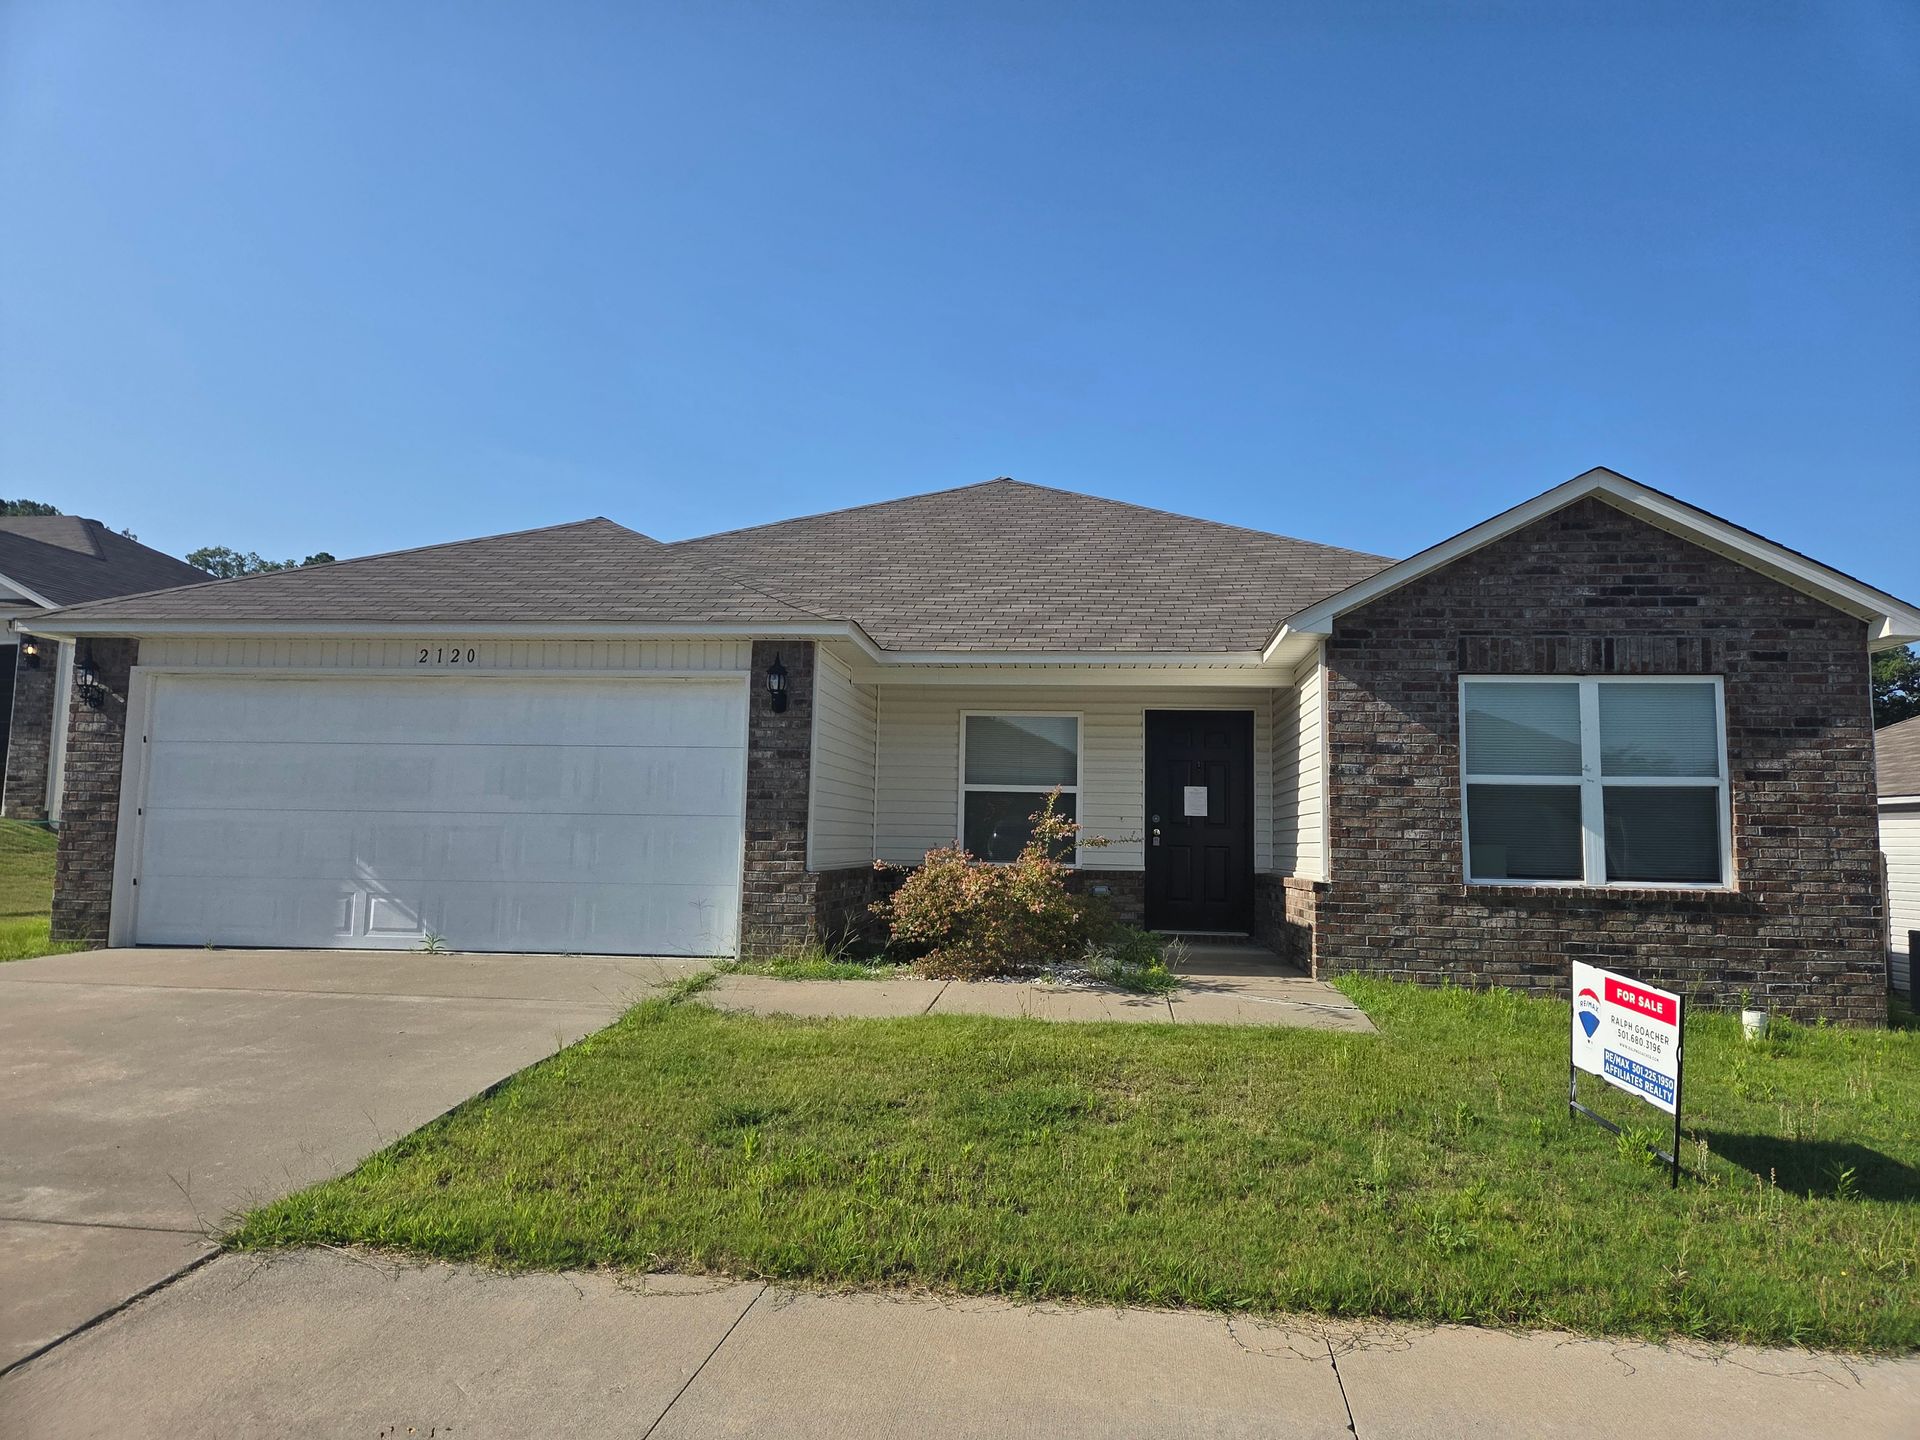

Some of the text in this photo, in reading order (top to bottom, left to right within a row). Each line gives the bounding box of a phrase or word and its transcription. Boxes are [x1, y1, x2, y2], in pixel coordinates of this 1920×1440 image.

[419, 648, 475, 663] 2120
[1579, 999, 1599, 1012] RE/MAX
[1616, 988, 1663, 1014] FOR SALE
[1610, 1015, 1669, 1045] RALPH GOACHER
[1617, 1029, 1662, 1054] 501.680.3196
[1605, 1052, 1630, 1071] RE/MAX
[1632, 1064, 1673, 1089] 501.225.1950
[1605, 1064, 1673, 1103] AFFILIATES REALTY
